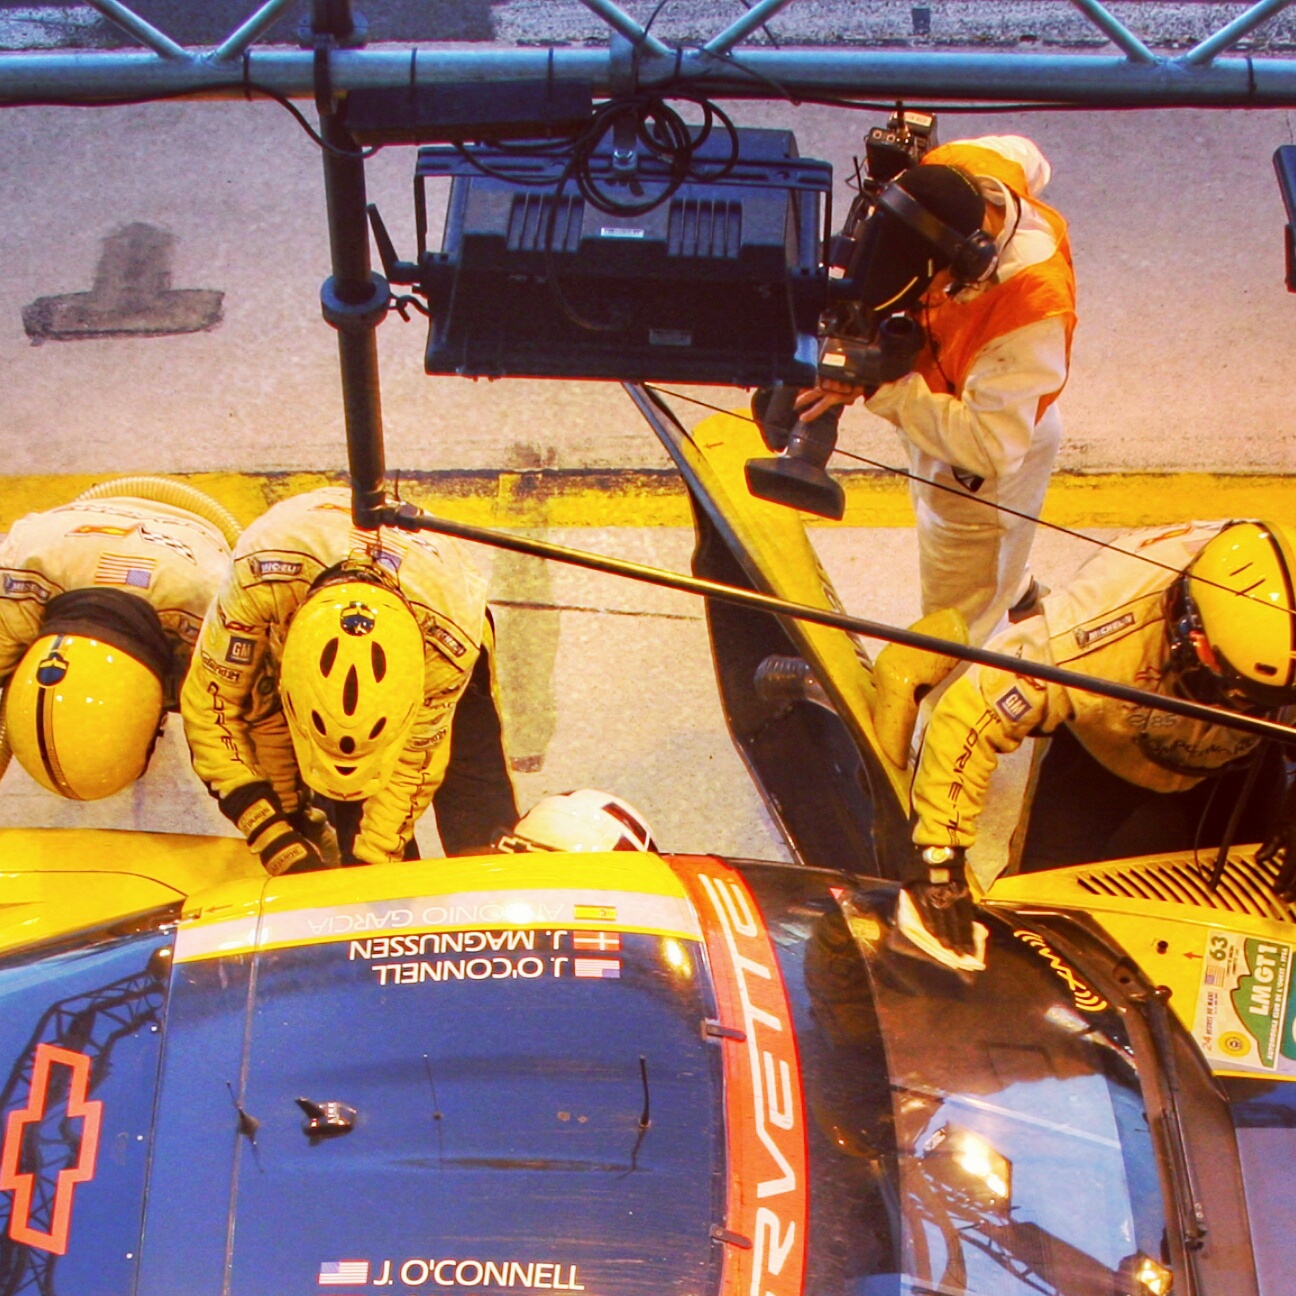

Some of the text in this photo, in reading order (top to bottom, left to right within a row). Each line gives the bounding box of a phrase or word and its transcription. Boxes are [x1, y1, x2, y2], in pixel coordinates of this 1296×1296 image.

[232, 641, 252, 658] GM
[1004, 691, 1027, 718] GM
[349, 929, 568, 961] J. MAGNUSSEN
[1209, 935, 1229, 961] 63
[371, 956, 569, 986] J. O'CONNELL
[1249, 943, 1278, 1016] LM GT1
[372, 1258, 586, 1291] J. O'CONNELL
